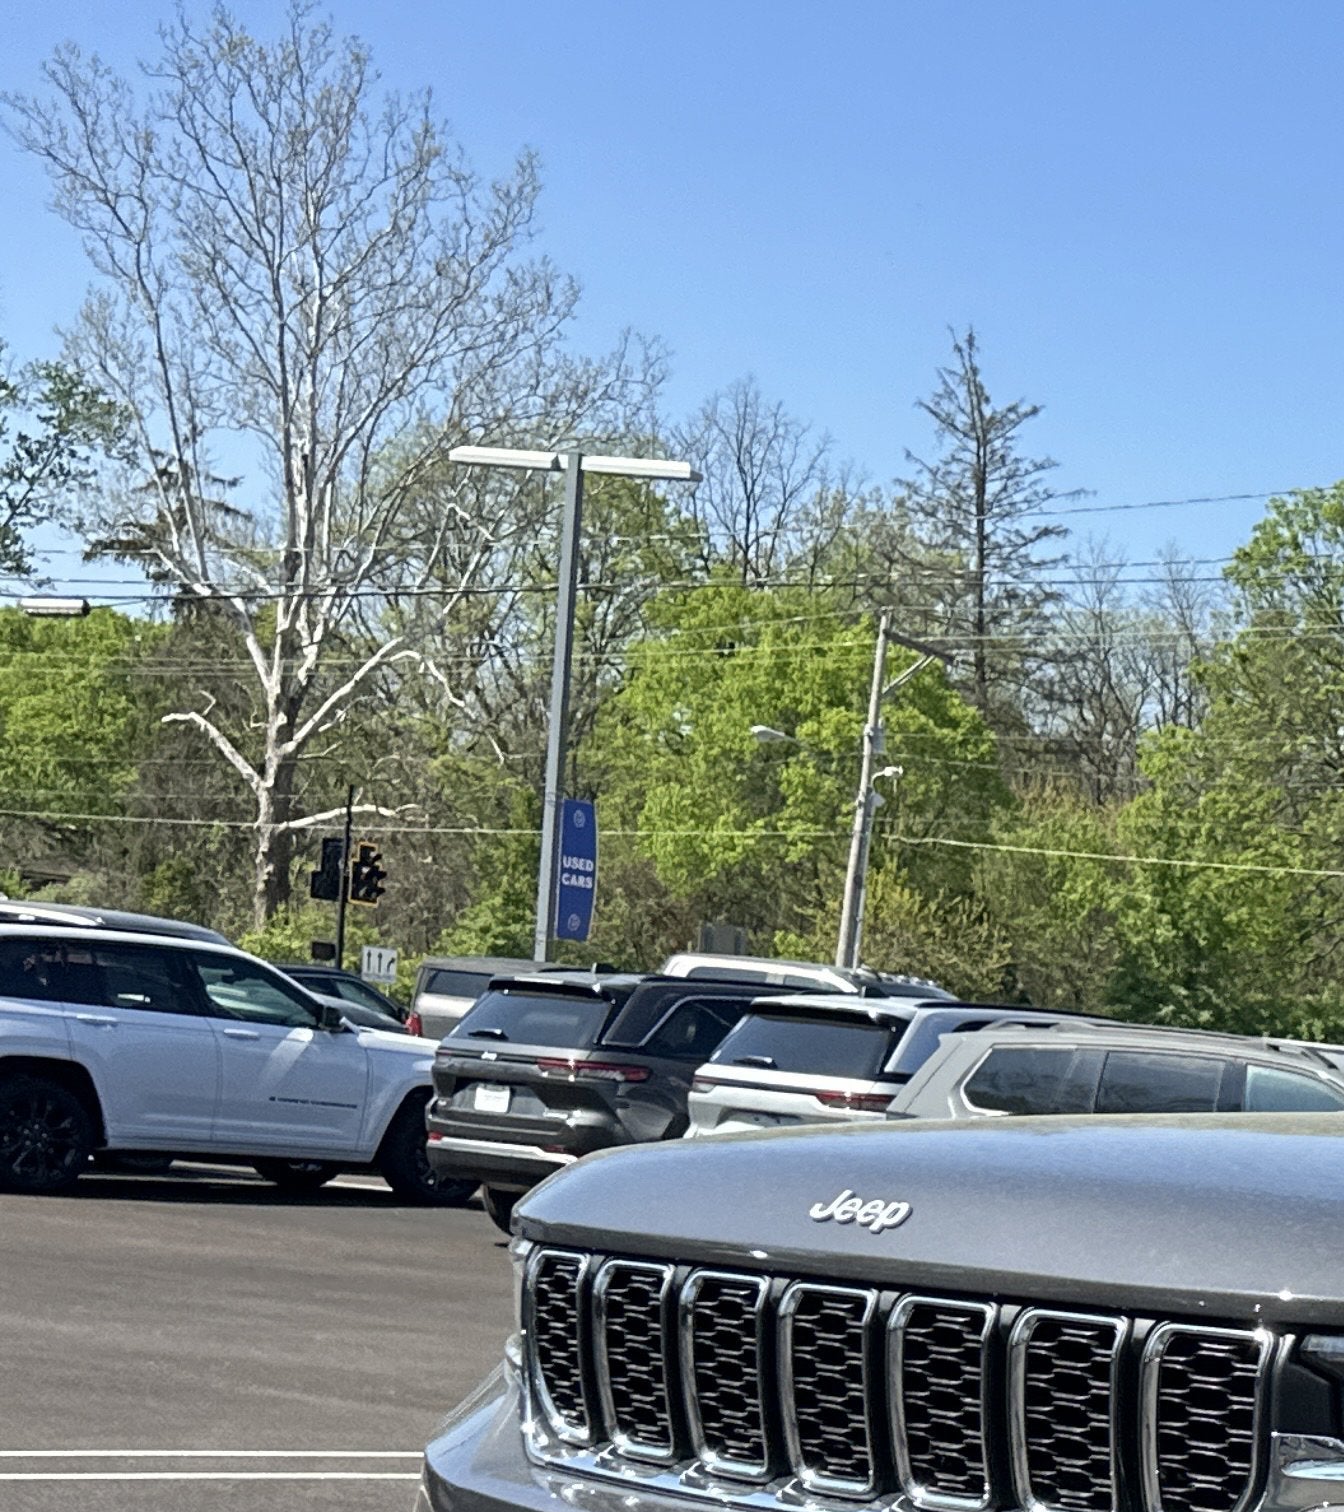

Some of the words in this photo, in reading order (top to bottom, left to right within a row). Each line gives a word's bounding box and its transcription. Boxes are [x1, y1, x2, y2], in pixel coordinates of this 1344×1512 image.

[562, 855, 594, 872] USED
[561, 872, 593, 889] CARS
[809, 1189, 913, 1234] Jeep
